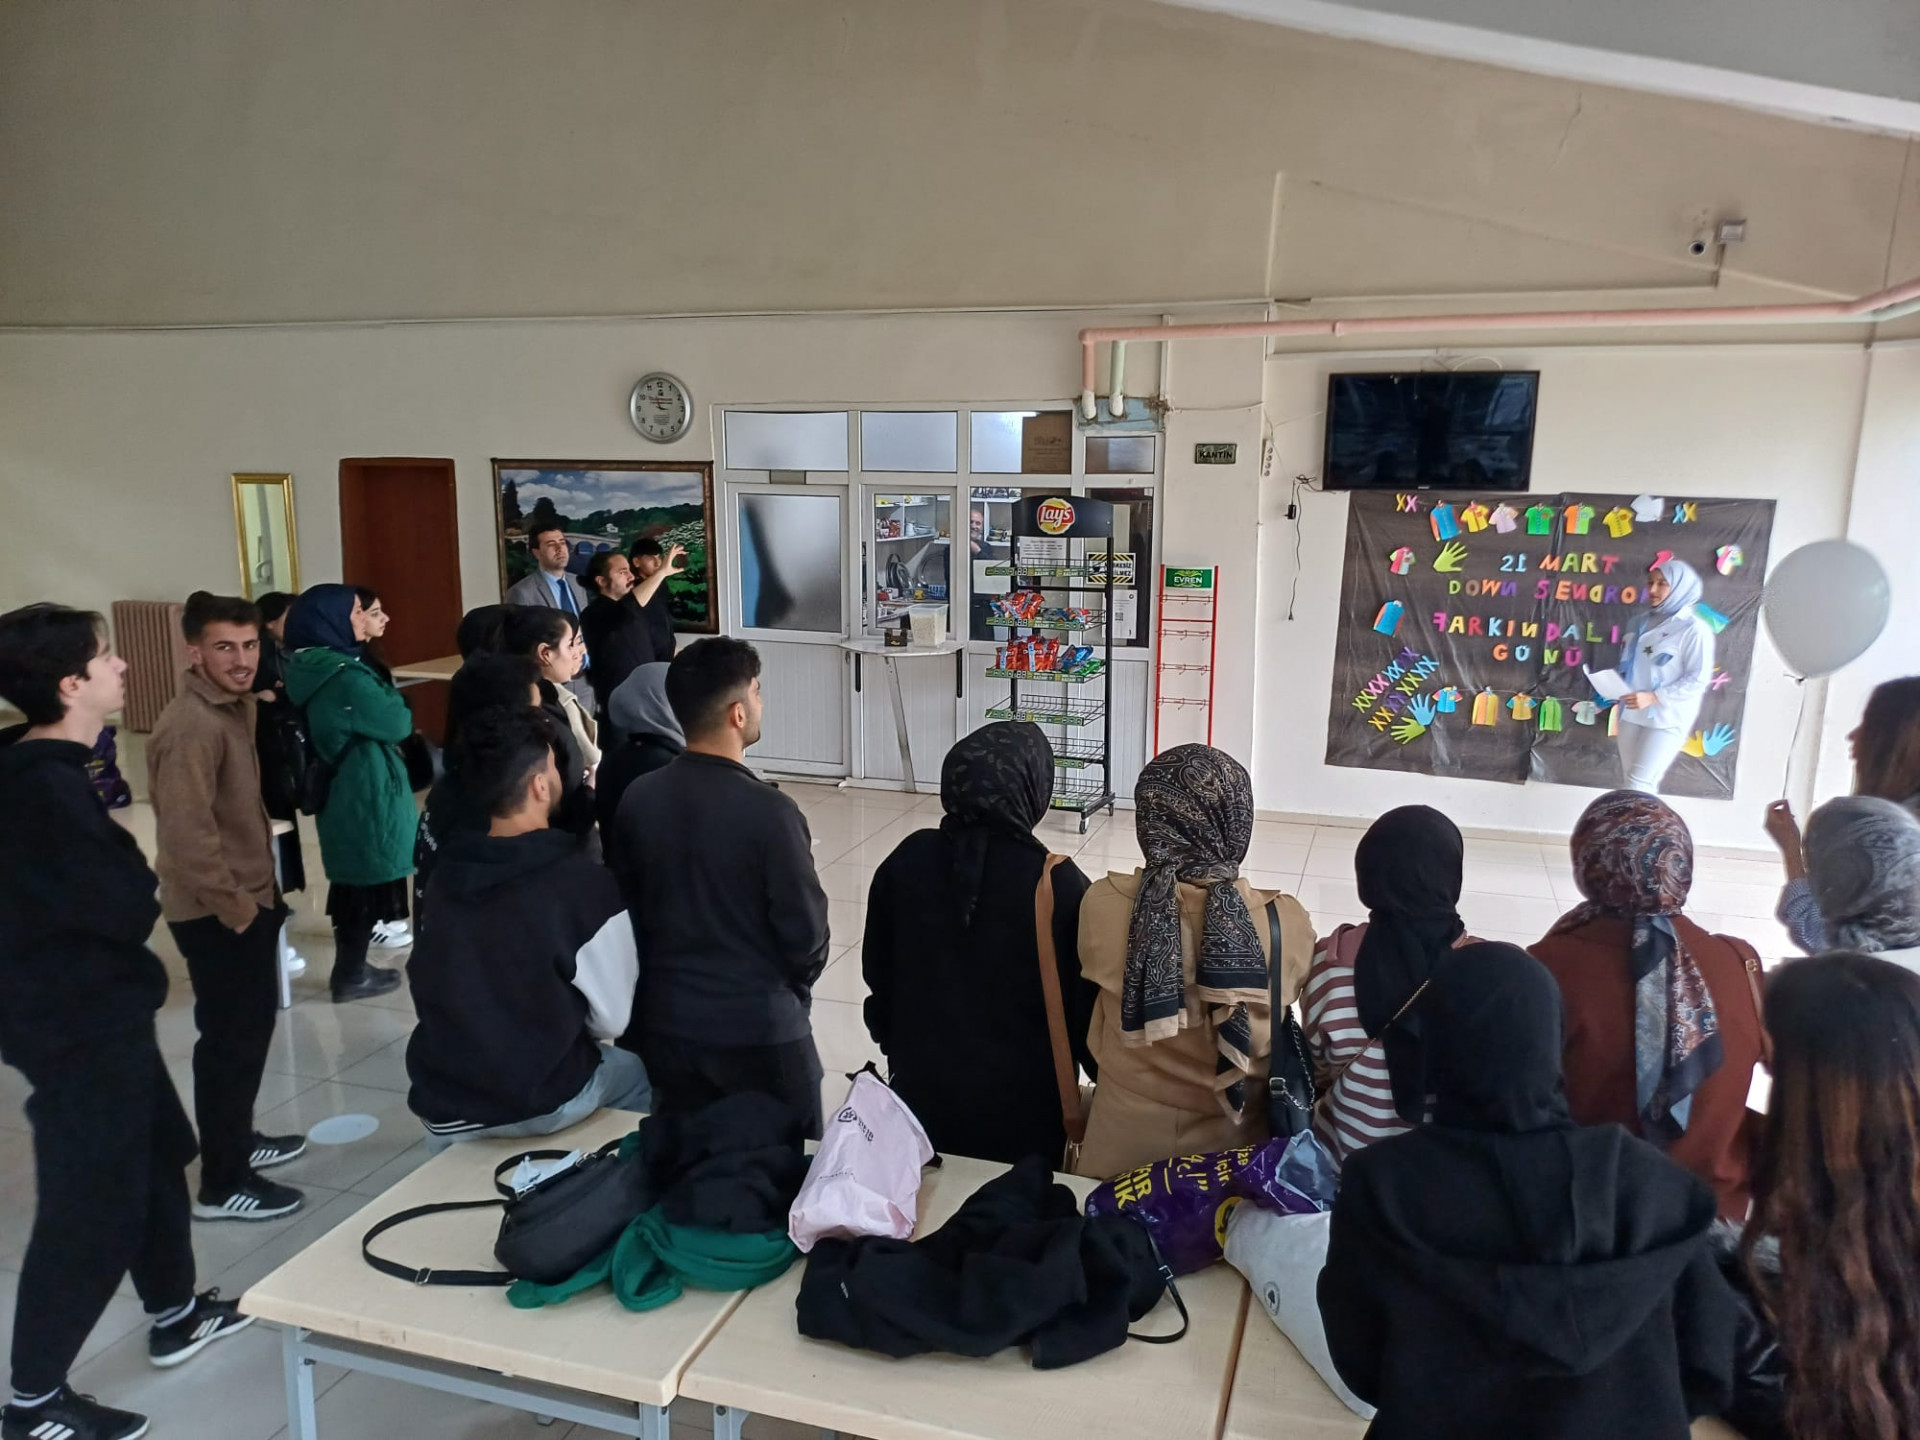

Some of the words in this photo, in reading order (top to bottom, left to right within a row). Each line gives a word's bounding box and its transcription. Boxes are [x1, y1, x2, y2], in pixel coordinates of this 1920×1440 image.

[1500, 553, 1528, 573] 21
[1539, 552, 1619, 575] MART
[1174, 576, 1202, 584] EVREN
[1449, 579, 1517, 598] DOWN
[1432, 612, 1620, 644] FARKINDALI
